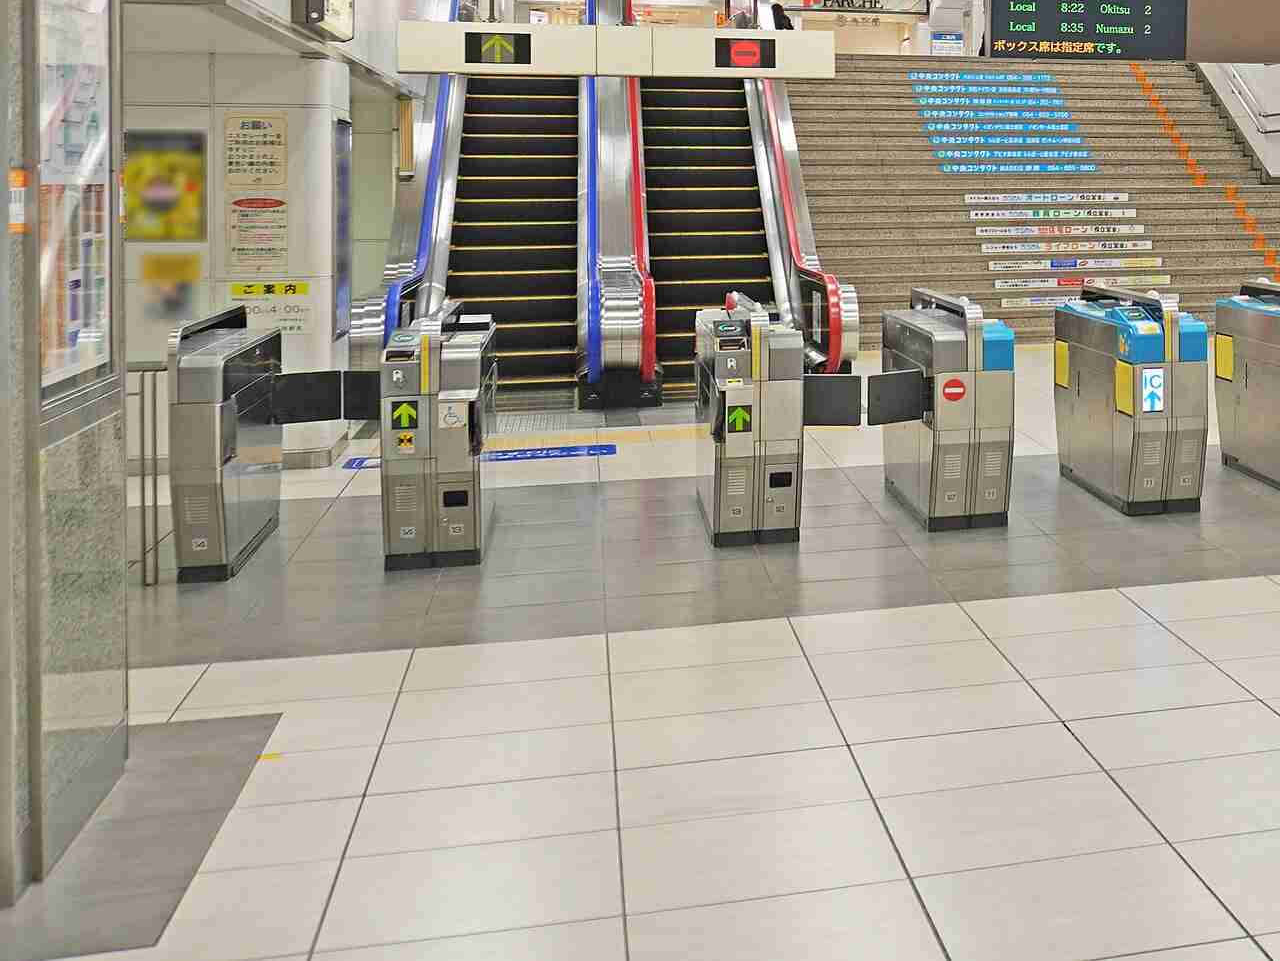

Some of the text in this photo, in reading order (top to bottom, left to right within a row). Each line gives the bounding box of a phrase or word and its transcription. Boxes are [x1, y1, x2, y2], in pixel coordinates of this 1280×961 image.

[1009, 1, 1152, 15] Local 8:22 Okitsu 2
[1009, 21, 1152, 35] Local 8:35 Numazu 2
[993, 40, 1122, 54] ボックス席は指定席です。
[244, 284, 297, 294] ご案内
[1143, 374, 1162, 389] IC
